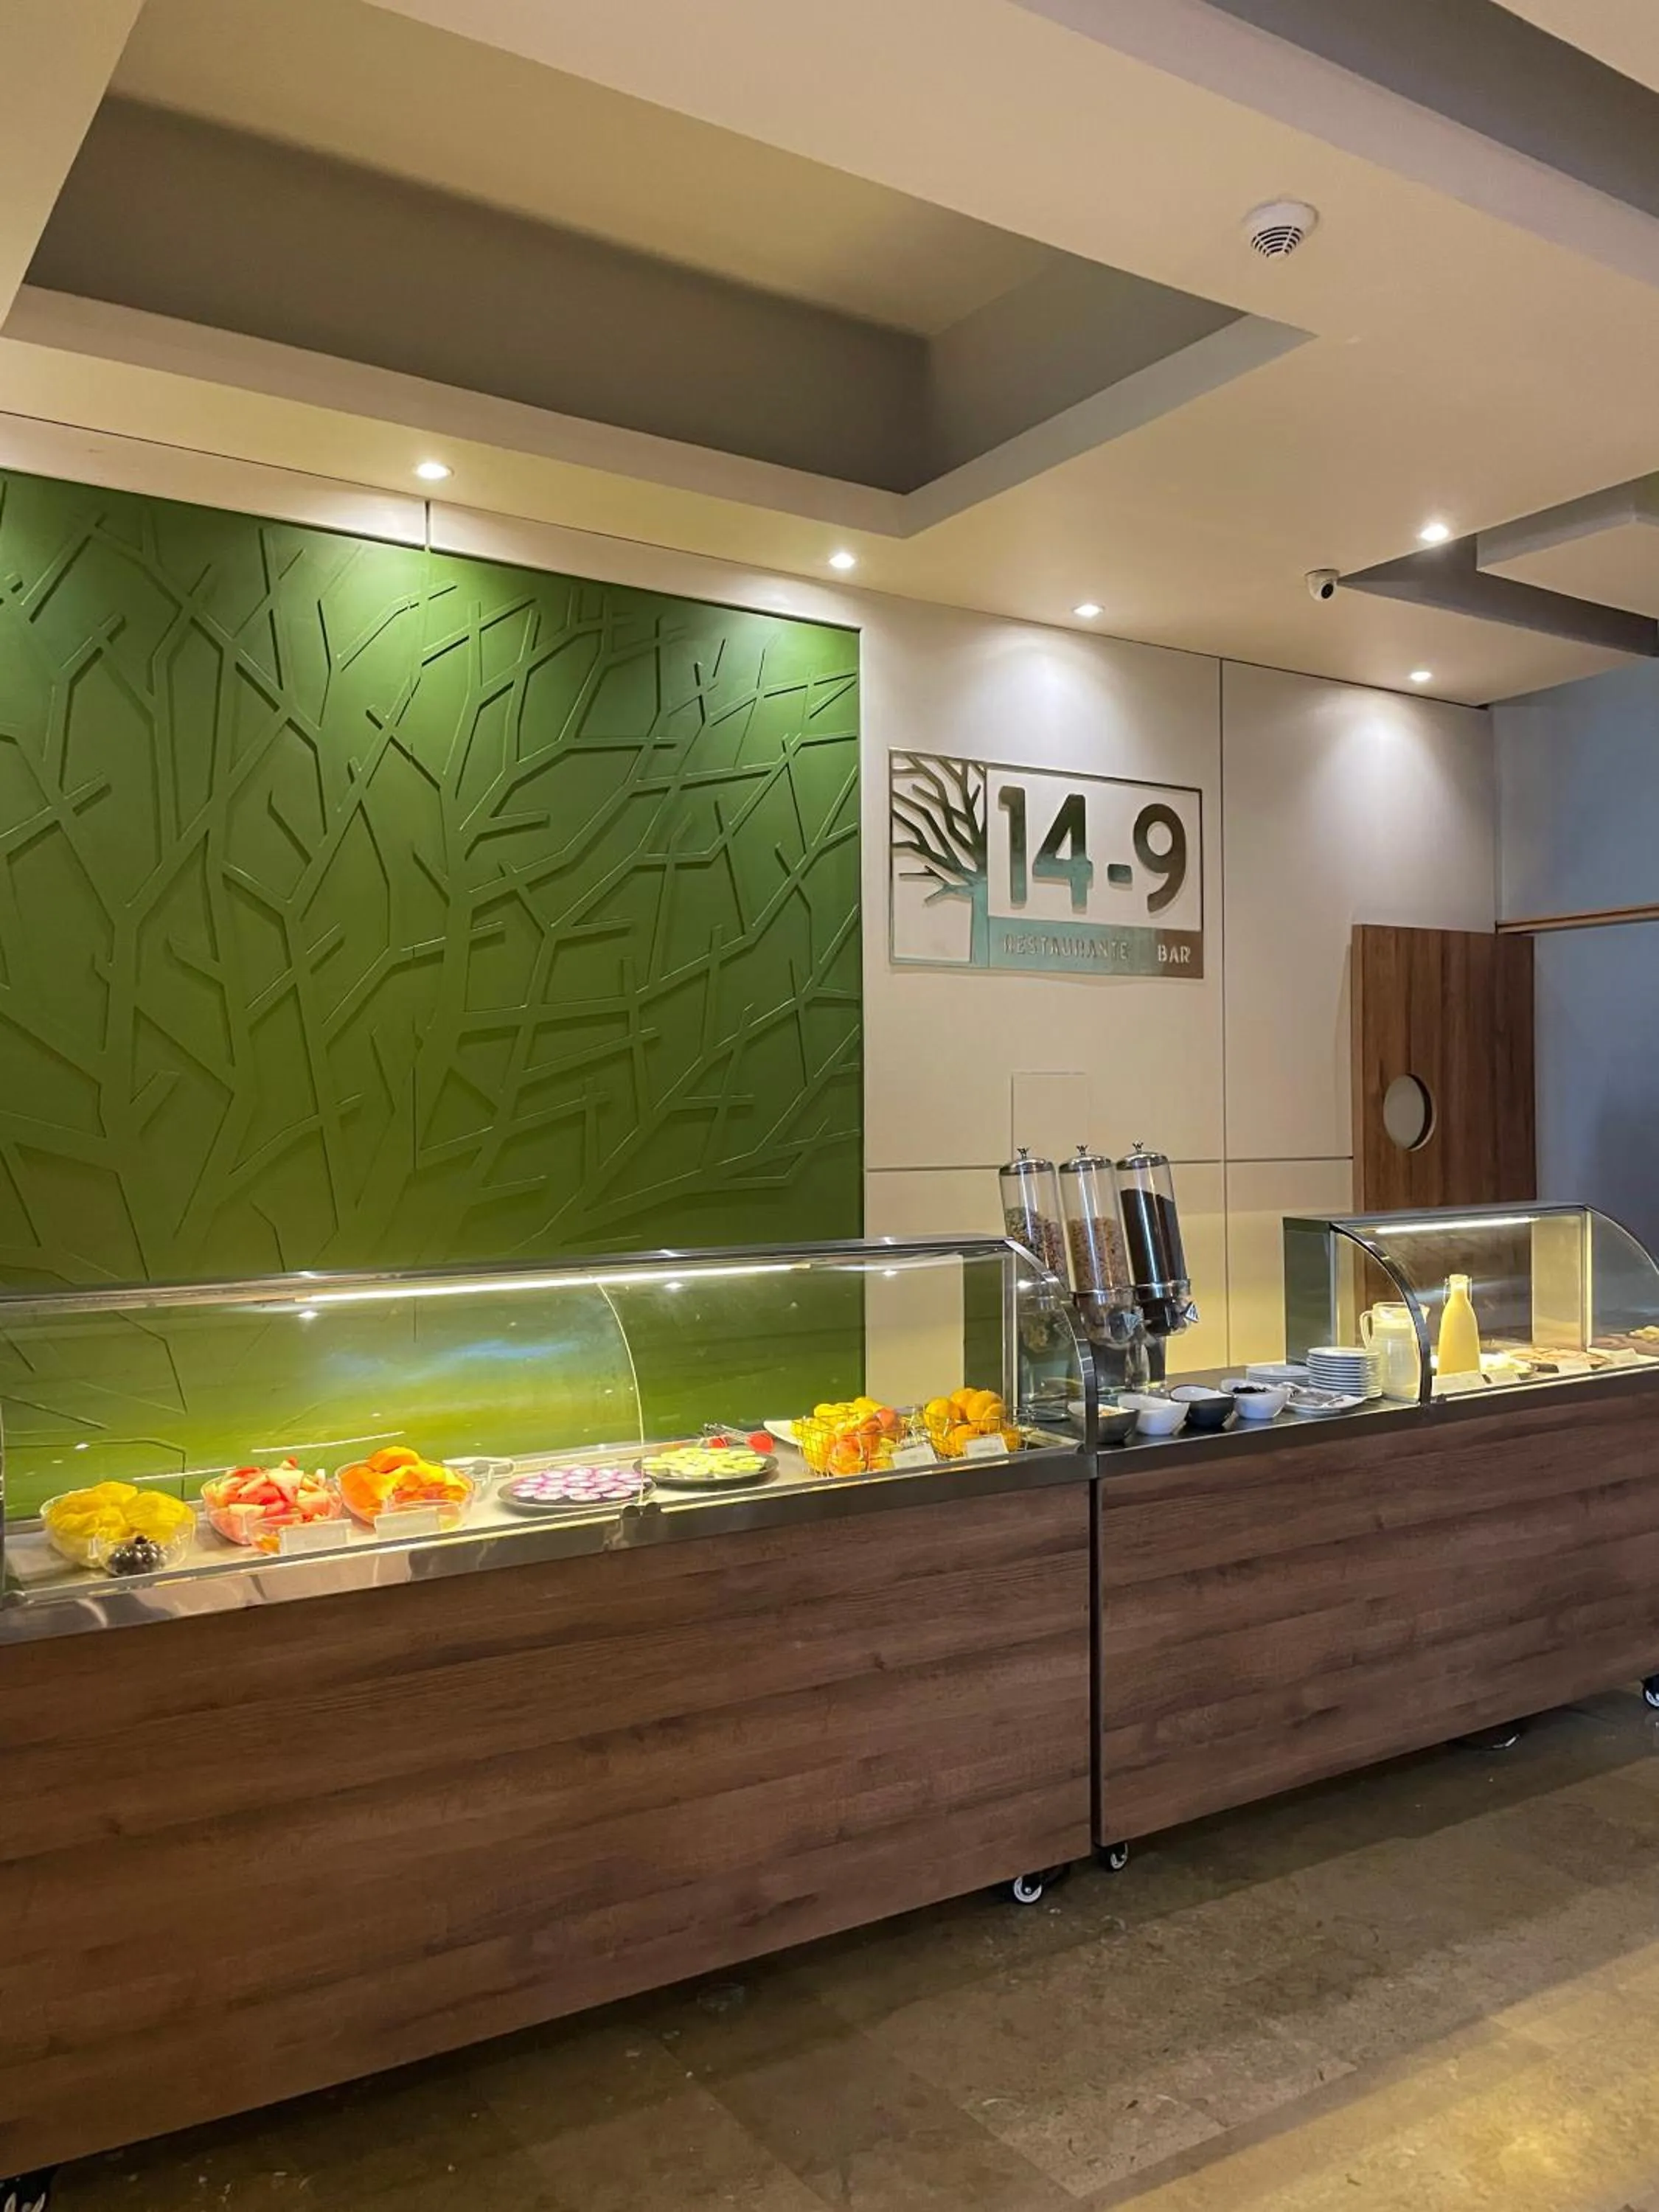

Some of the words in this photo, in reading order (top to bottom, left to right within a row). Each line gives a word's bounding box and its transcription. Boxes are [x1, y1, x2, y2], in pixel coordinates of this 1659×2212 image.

[998, 785, 1186, 912] 14-9
[1004, 934, 1129, 959] RESTAURANTE
[1158, 944, 1191, 963] BAR
